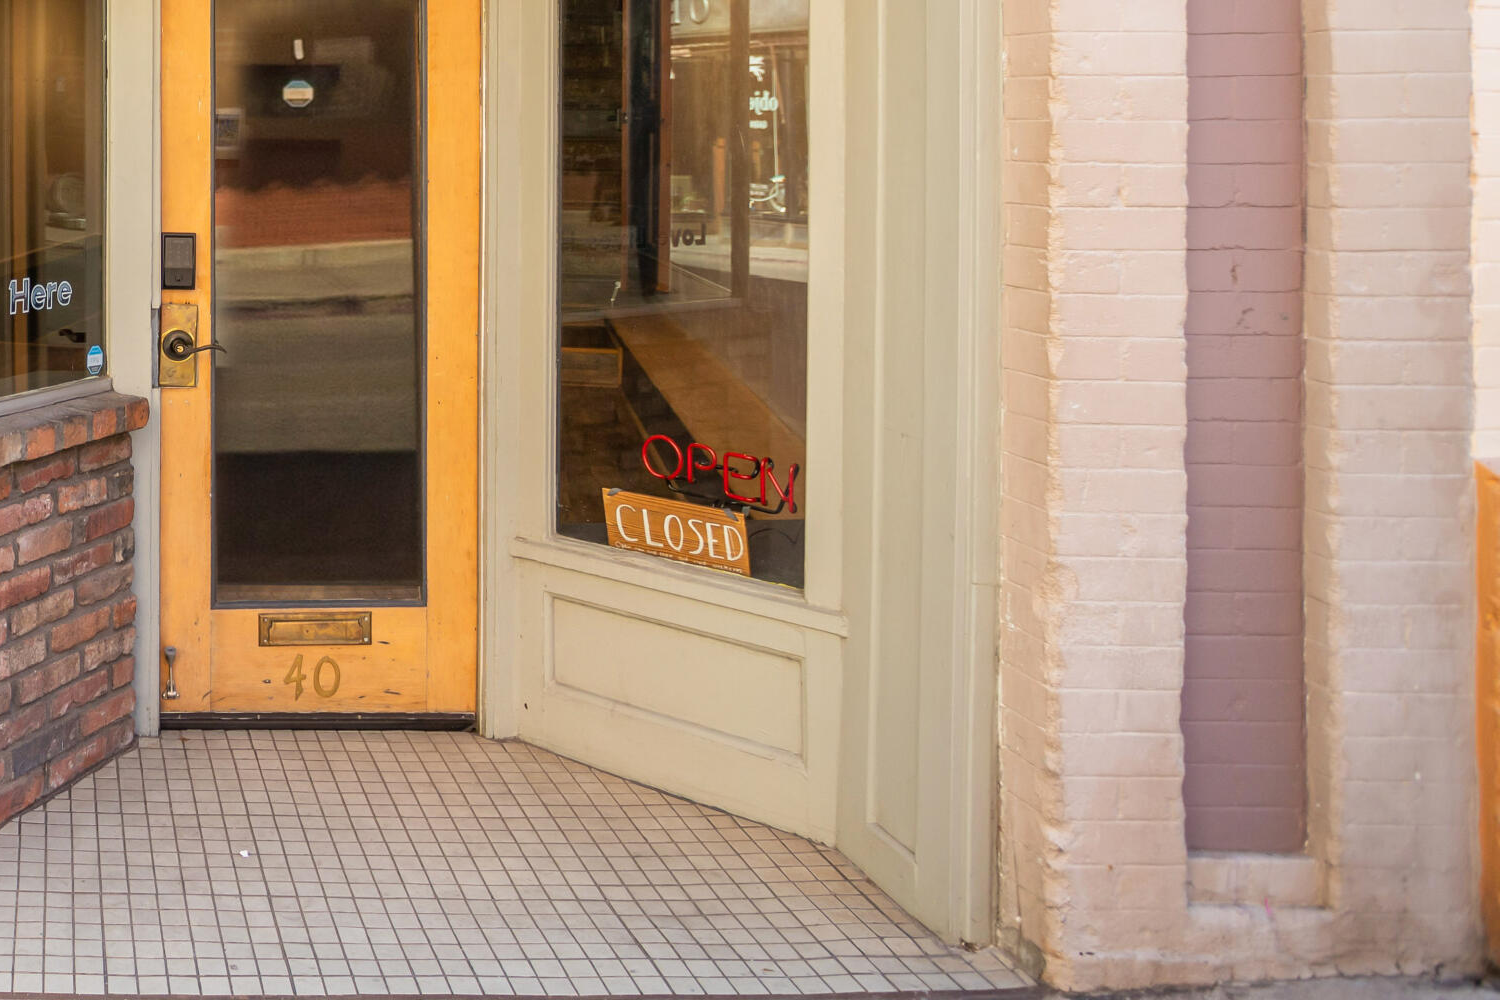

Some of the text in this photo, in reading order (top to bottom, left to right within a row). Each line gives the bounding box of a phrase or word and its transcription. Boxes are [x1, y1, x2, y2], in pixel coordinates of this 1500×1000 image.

[8, 276, 73, 316] Here
[641, 433, 800, 514] OPEN
[615, 503, 745, 562] CLOSED
[283, 653, 341, 702] 40
